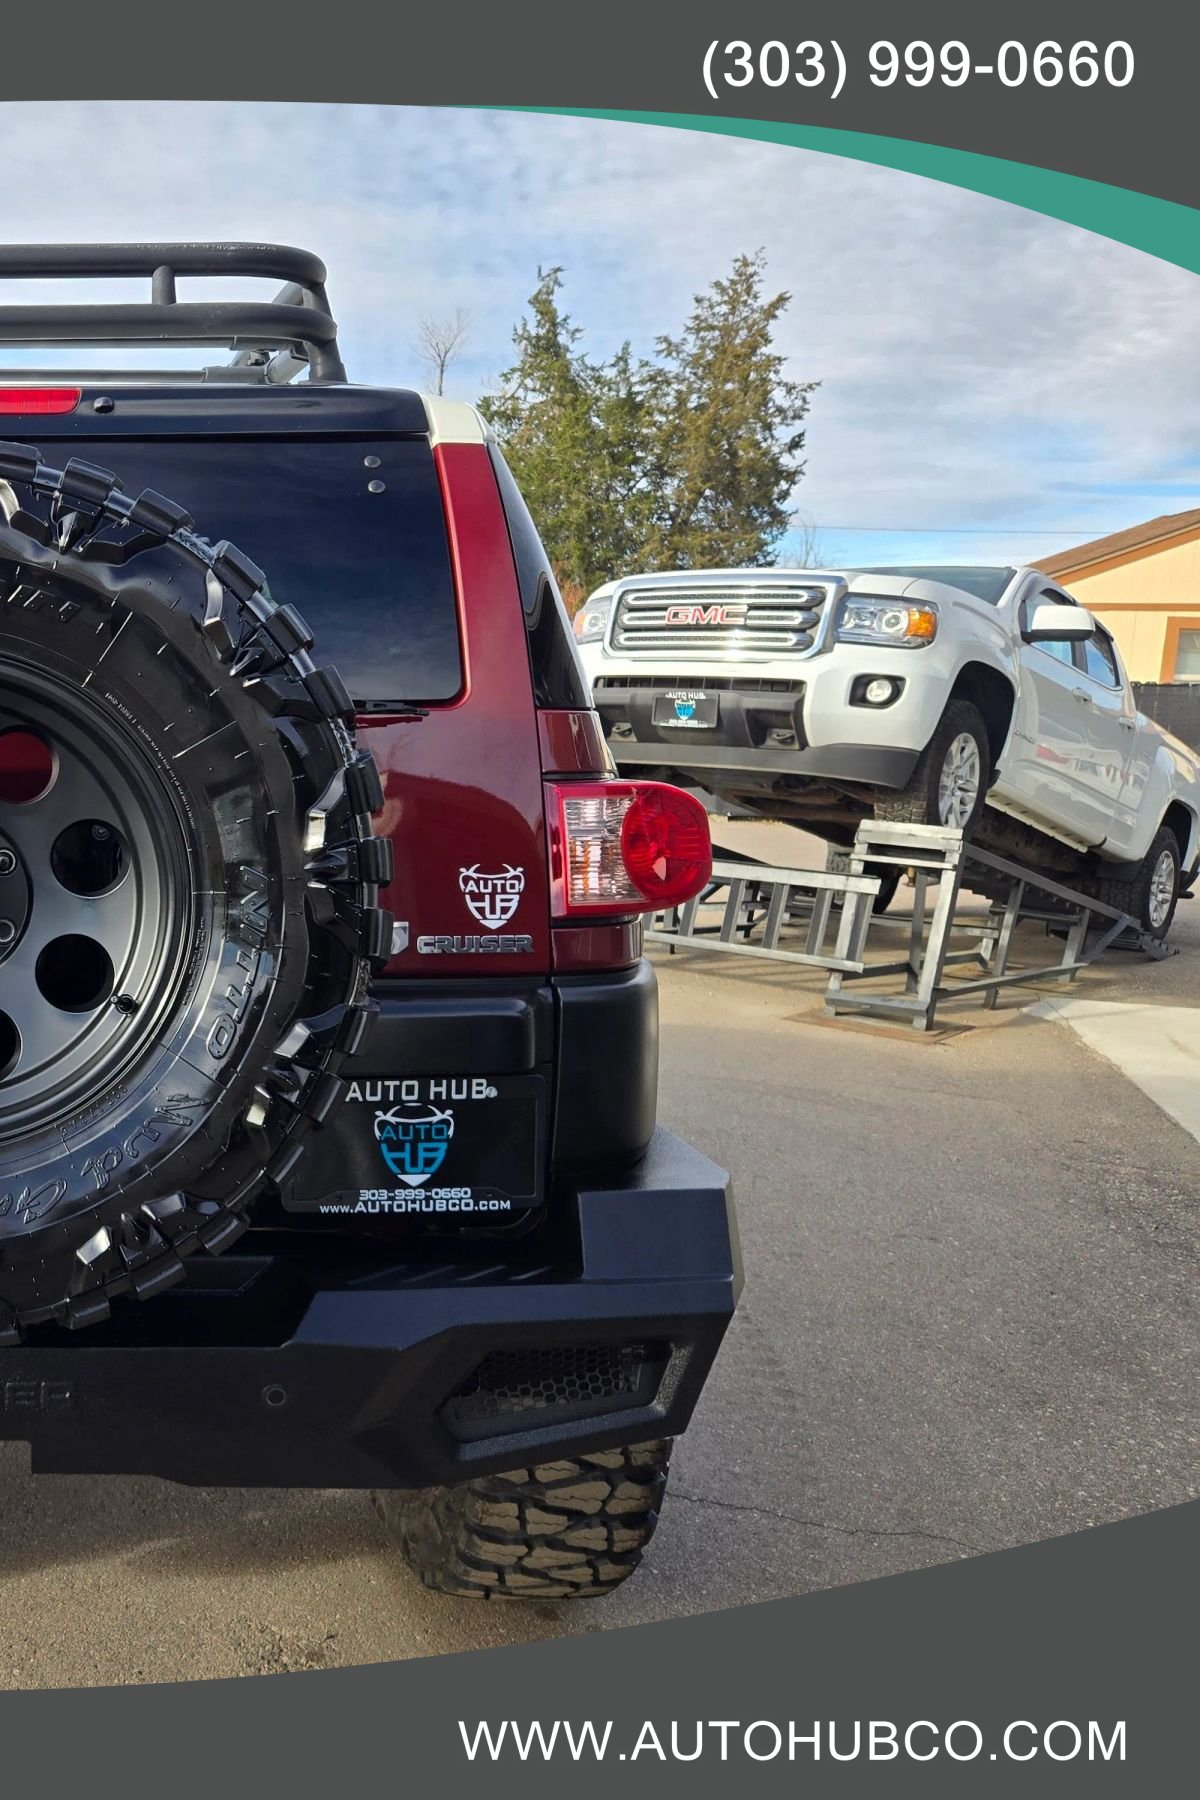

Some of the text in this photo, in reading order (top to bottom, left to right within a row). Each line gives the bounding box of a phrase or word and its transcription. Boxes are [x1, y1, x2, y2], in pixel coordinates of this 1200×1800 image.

[665, 604, 748, 625] GMC
[465, 880, 519, 893] AUTO
[465, 895, 520, 919] HUB
[417, 935, 535, 954] CRUISER
[206, 865, 272, 1059] NITTO
[345, 1079, 488, 1102] AUTO HUB
[381, 1124, 448, 1140] AUTO
[380, 1142, 448, 1174] HUB
[359, 1187, 471, 1200] 303-999-0660
